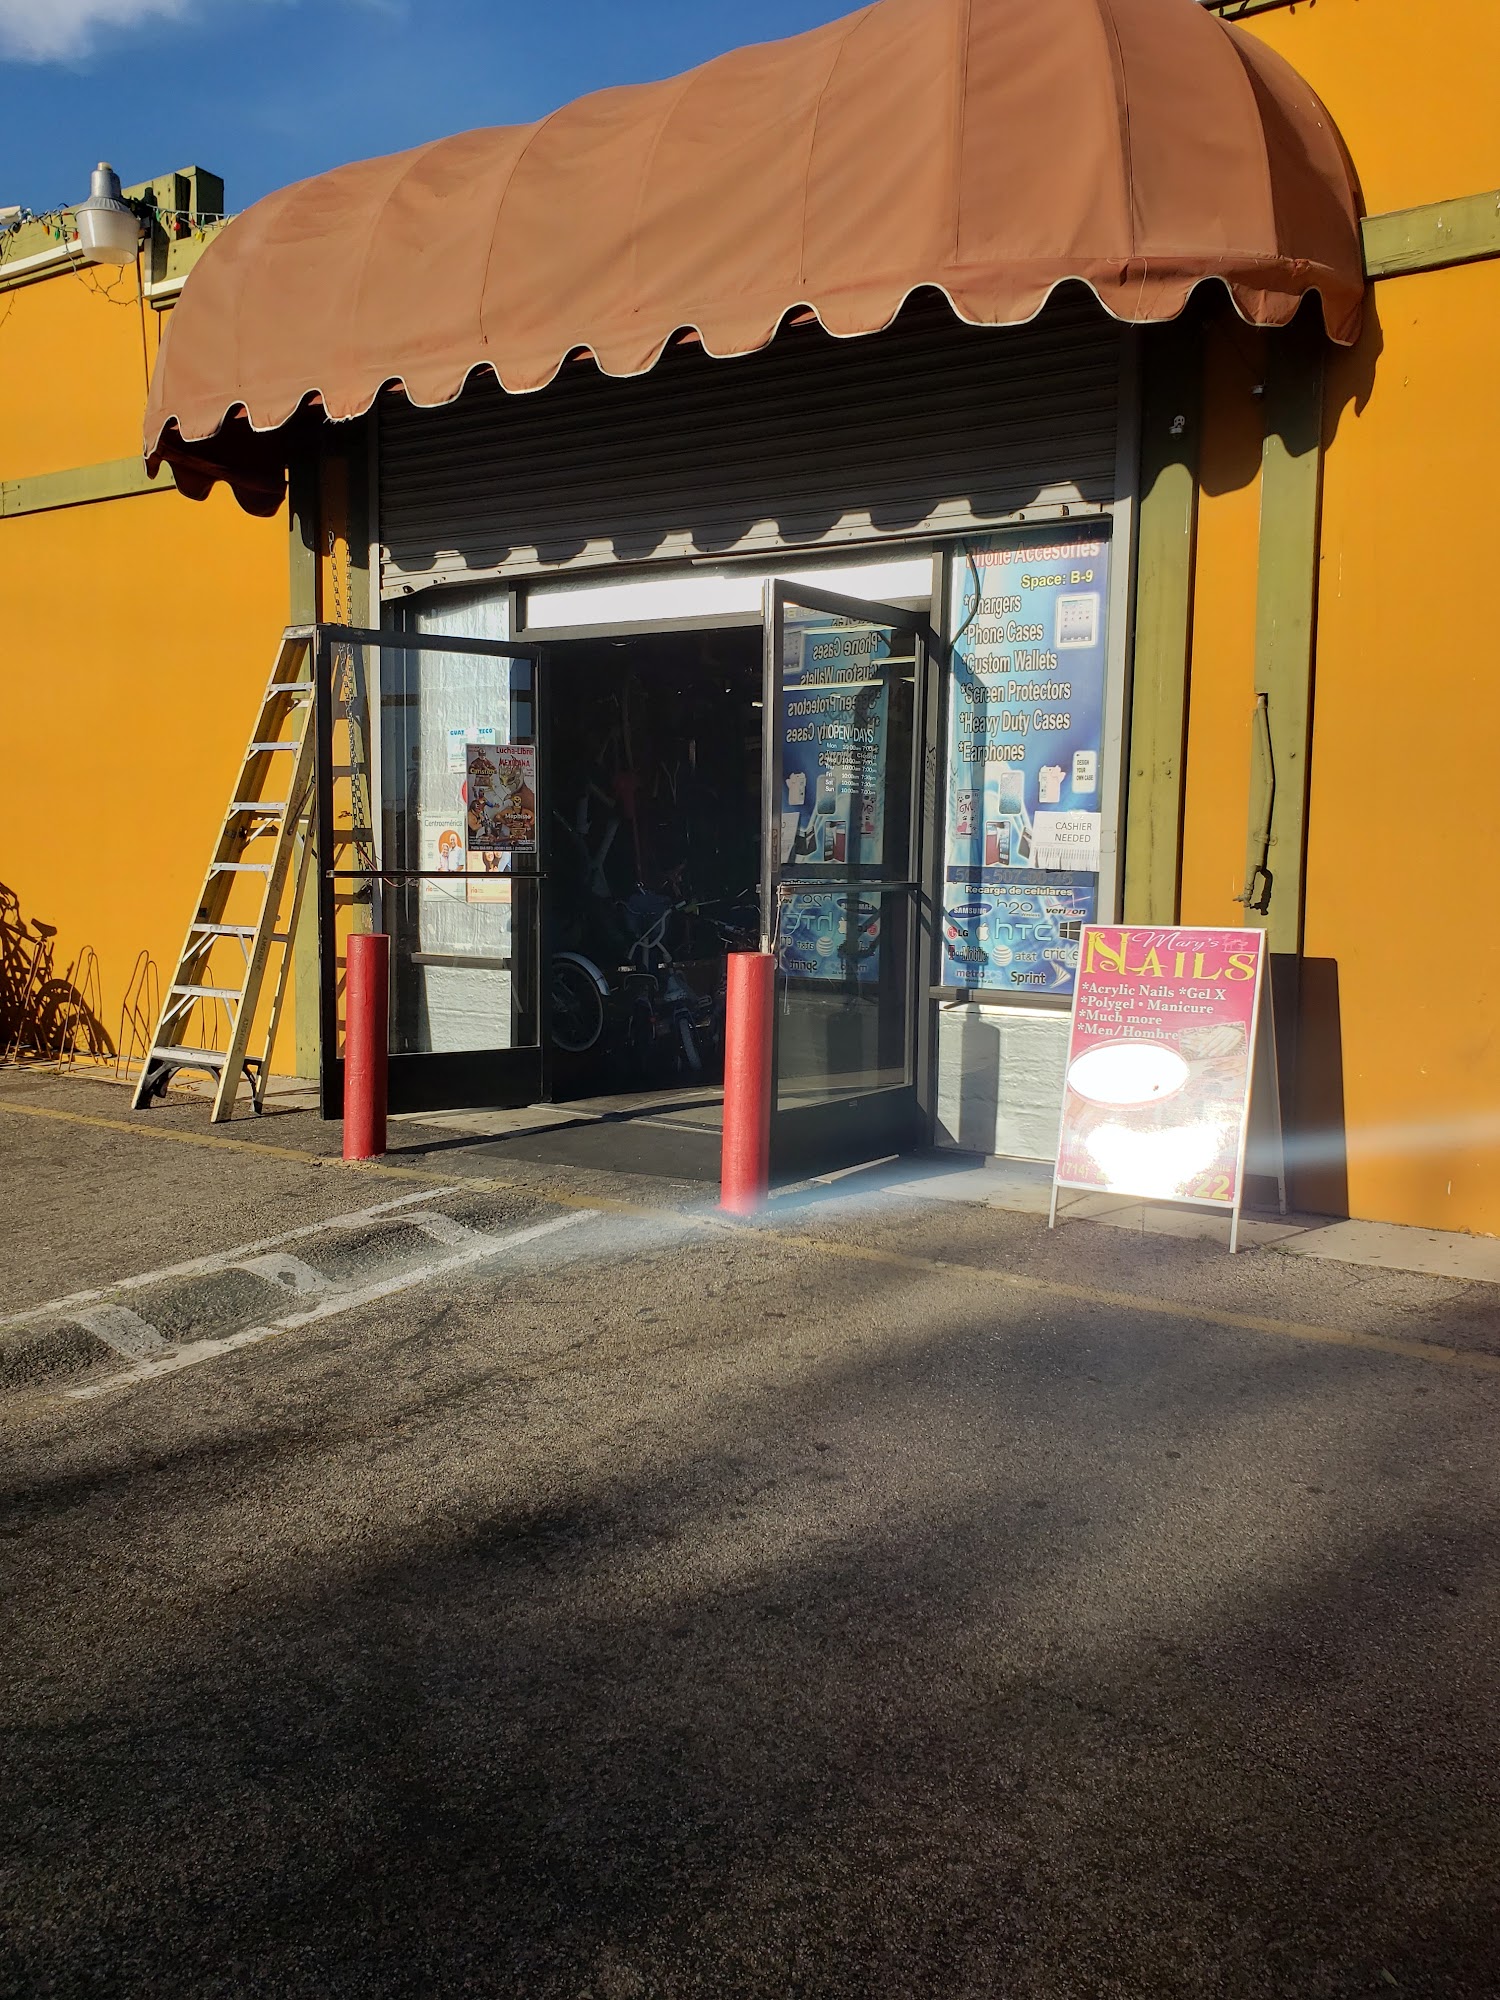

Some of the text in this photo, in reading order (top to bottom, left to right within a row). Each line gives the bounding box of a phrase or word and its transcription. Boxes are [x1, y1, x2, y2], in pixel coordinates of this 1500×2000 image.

[966, 540, 1101, 568] Phone Accesories
[1021, 569, 1094, 590] Space: B-9
[1006, 620, 1044, 642] Cases
[1014, 649, 1058, 672] Wallets
[1007, 679, 1072, 702] Protectors
[1001, 710, 1030, 736] Duty
[1033, 708, 1071, 730] Cases
[828, 723, 850, 741] OPEN
[853, 728, 874, 743] DAYS
[496, 747, 534, 755] Lucha-Libre
[1055, 821, 1092, 831] CASHIER
[1054, 833, 1091, 843] NEEDED
[964, 885, 1073, 897] Recarga de celulares
[953, 906, 988, 915] SAMSUNG
[1046, 906, 1086, 917] verizon
[958, 929, 969, 937] LG
[1132, 931, 1220, 951] Mary's
[1015, 950, 1037, 962] at&t
[1043, 943, 1079, 961] cricke
[1082, 930, 1256, 981] NAILS
[1011, 970, 1046, 986] Sprint
[1139, 985, 1175, 998] Nails
[1212, 988, 1227, 1001] X
[1147, 1001, 1214, 1014] Manicure
[1126, 1014, 1162, 1025] more
